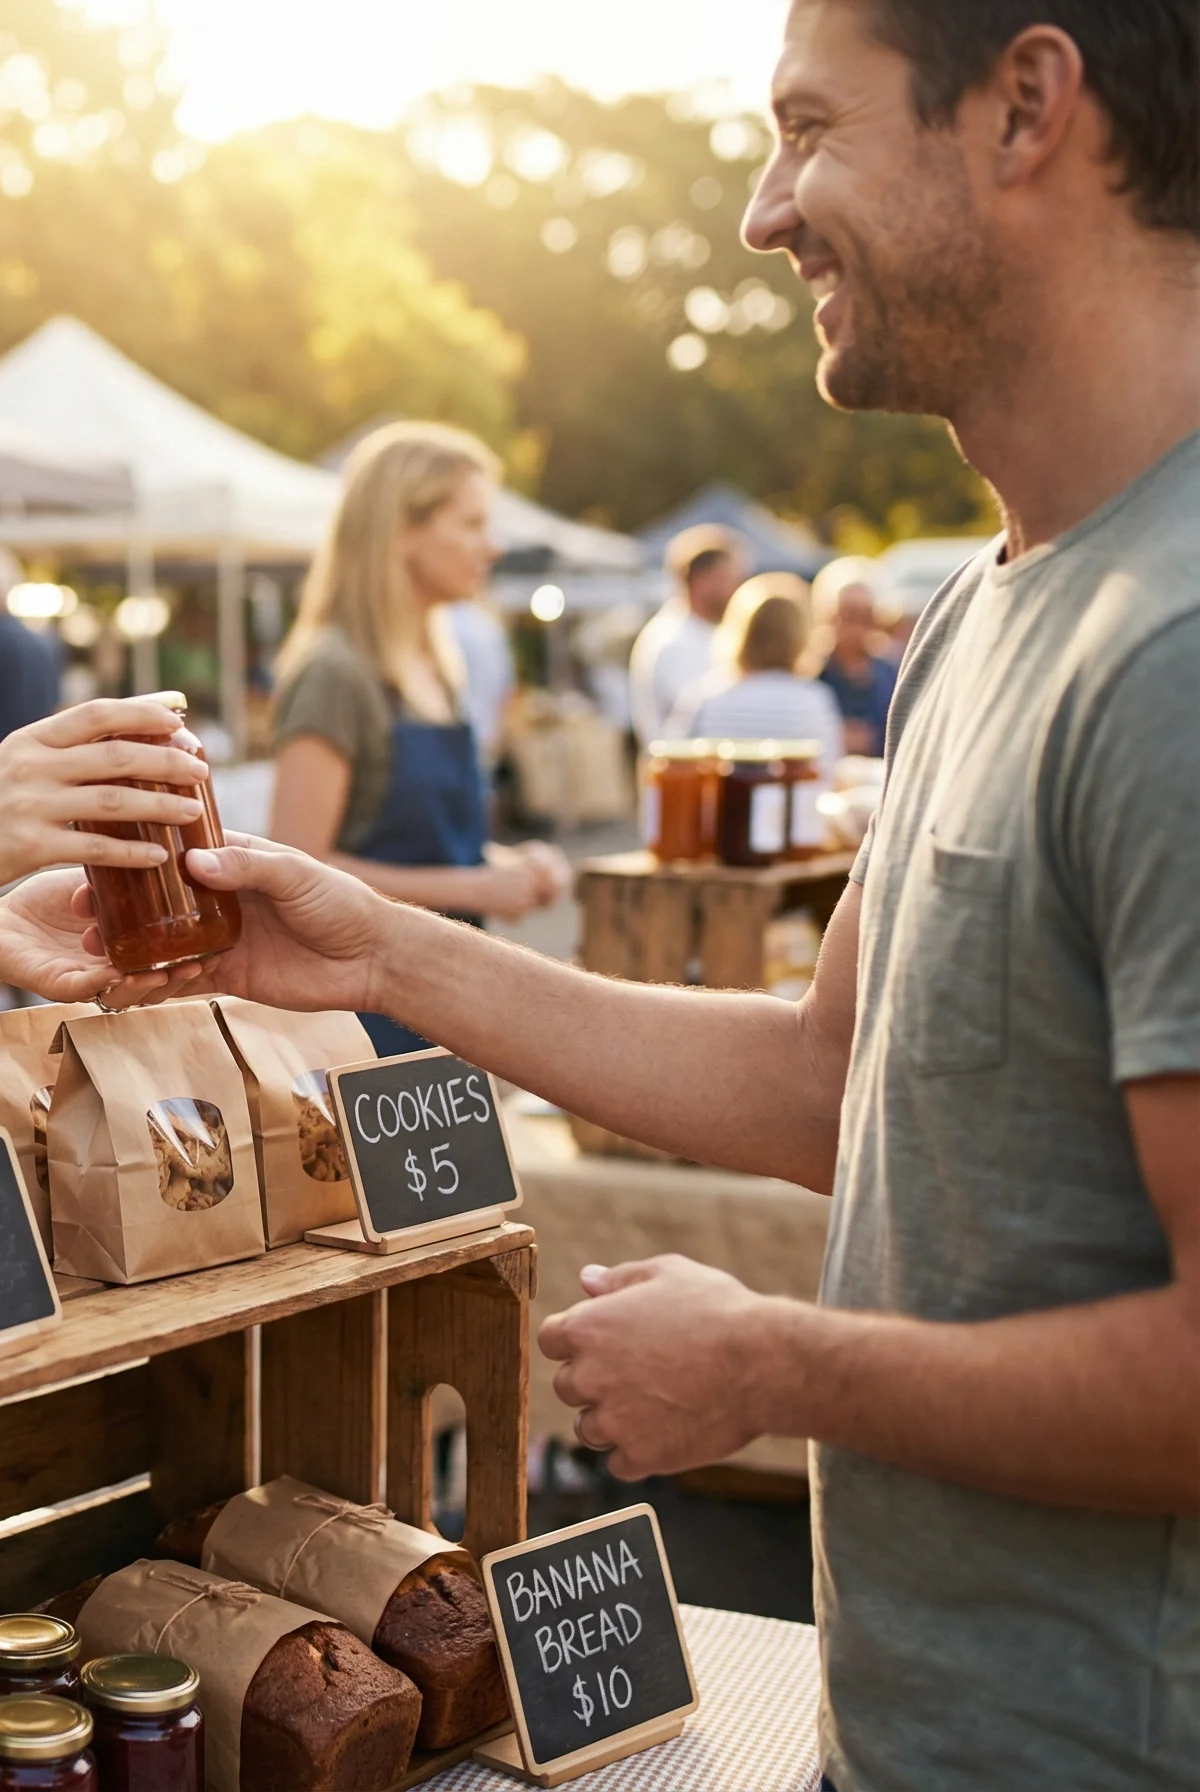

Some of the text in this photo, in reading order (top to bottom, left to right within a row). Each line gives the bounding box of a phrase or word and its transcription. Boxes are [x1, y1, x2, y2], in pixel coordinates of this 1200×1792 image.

[354, 1074, 490, 1144] COOKIES
[404, 1143, 459, 1201] $5
[506, 1539, 643, 1622] BANANA
[534, 1602, 643, 1673] BREAD
[572, 1665, 632, 1727] $10
